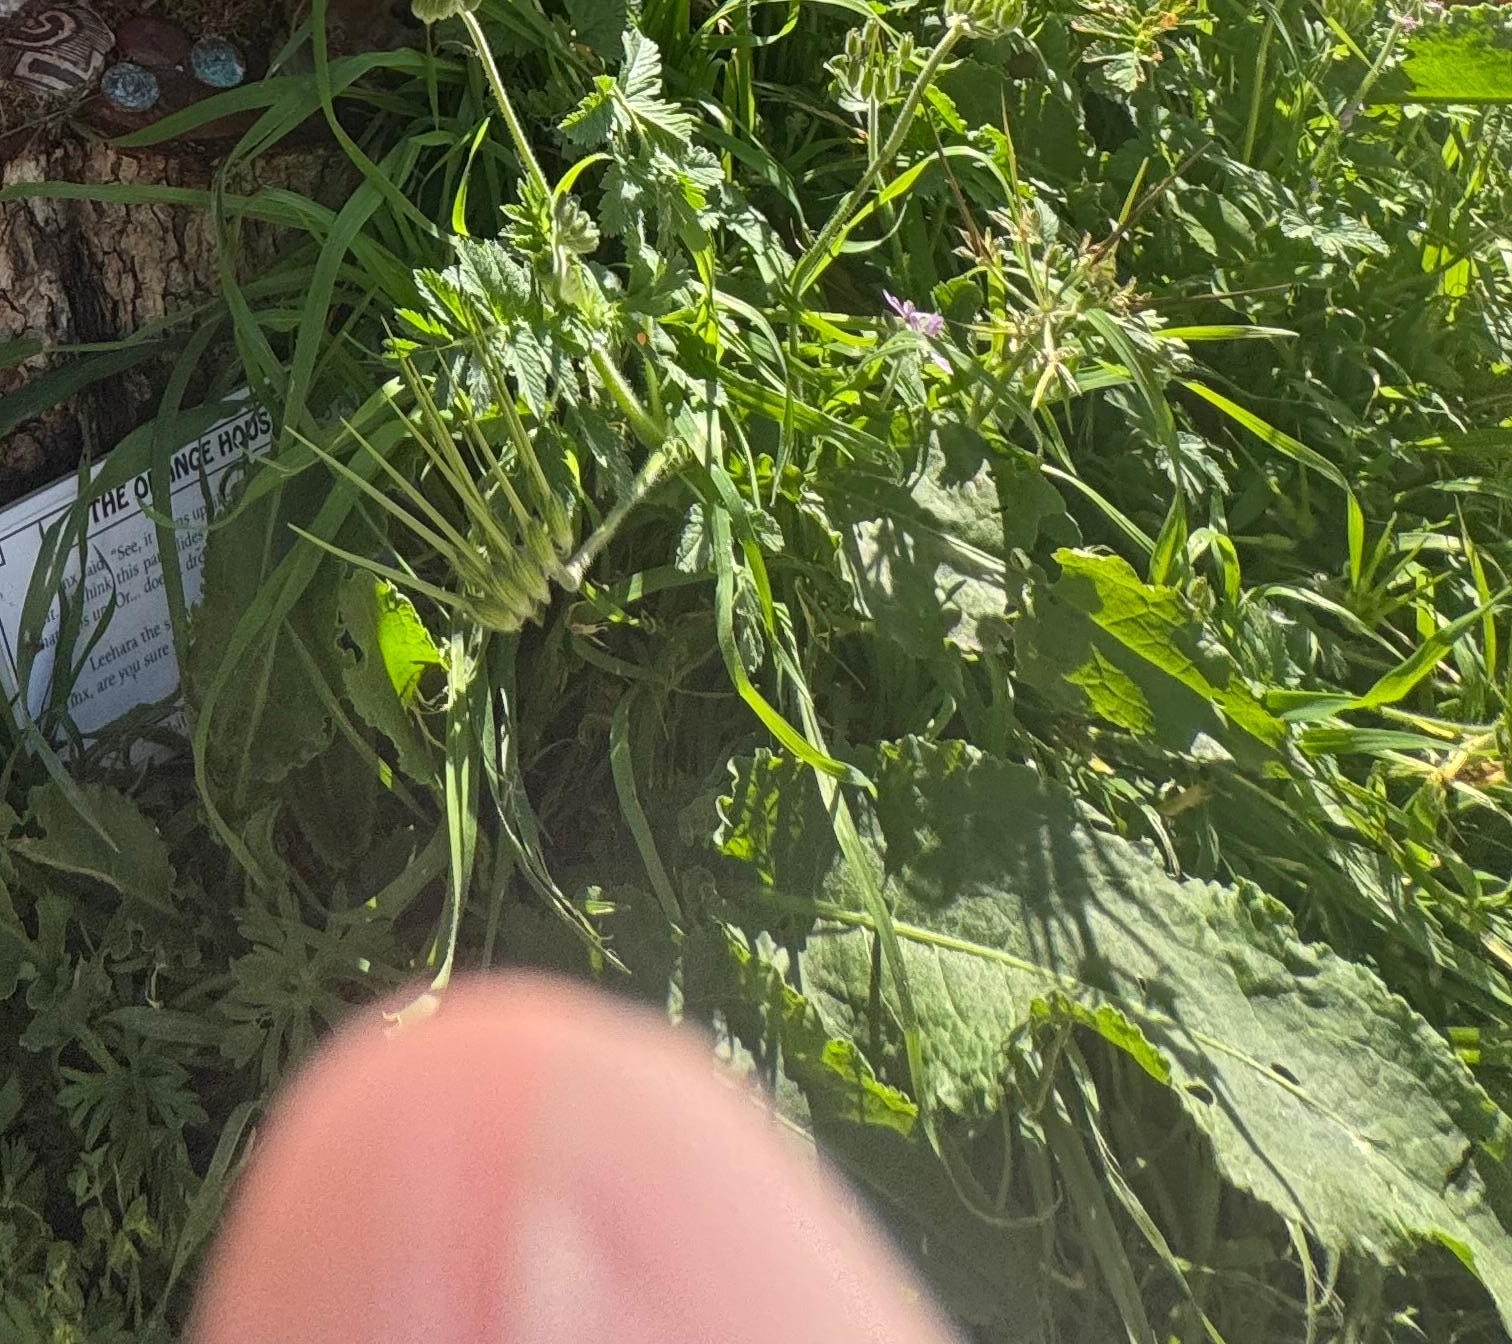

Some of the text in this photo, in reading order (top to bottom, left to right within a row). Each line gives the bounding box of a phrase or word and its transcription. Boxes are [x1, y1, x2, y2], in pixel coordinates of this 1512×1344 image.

[90, 411, 271, 524] THE ONGE HOUS
[116, 562, 139, 584] this
[140, 624, 161, 643] the
[97, 674, 116, 694] are
[143, 643, 170, 668] sure
